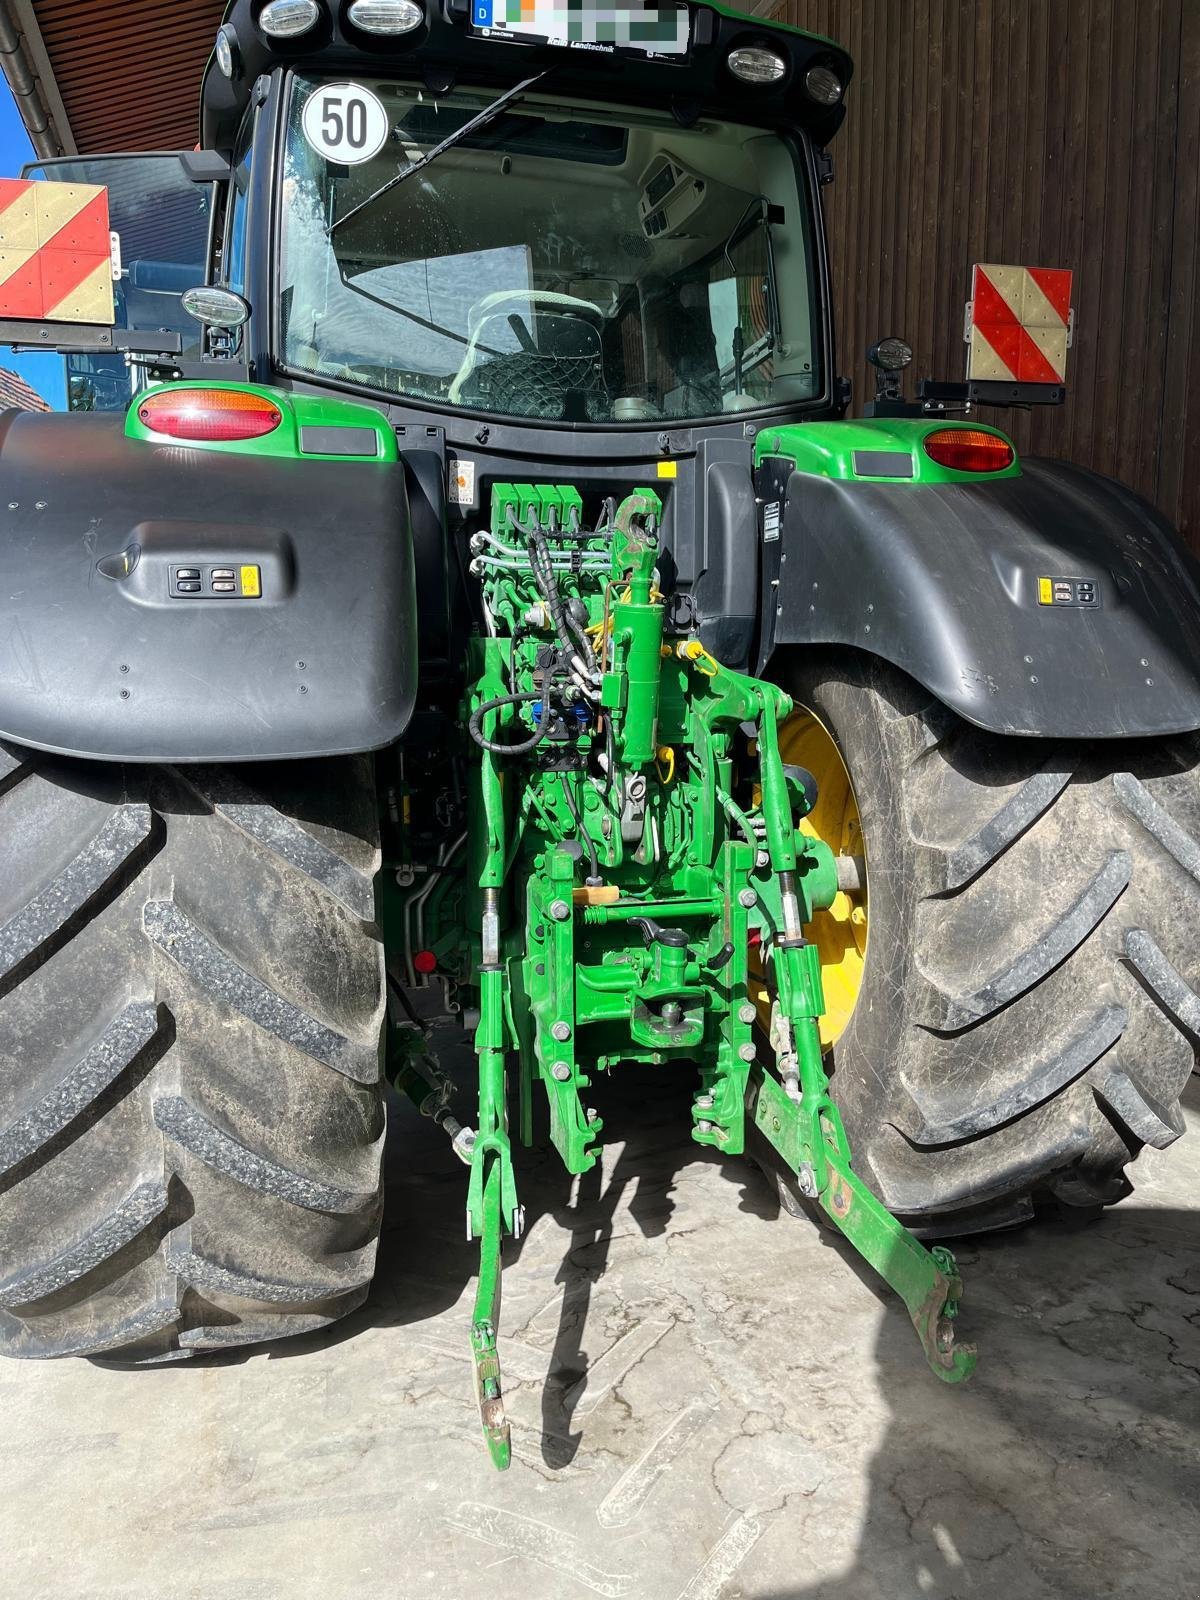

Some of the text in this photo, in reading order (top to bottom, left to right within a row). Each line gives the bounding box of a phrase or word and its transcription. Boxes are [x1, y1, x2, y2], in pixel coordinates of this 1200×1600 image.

[478, 7, 487, 19] D
[570, 40, 615, 53] Landtechnik
[322, 97, 367, 149] 50
